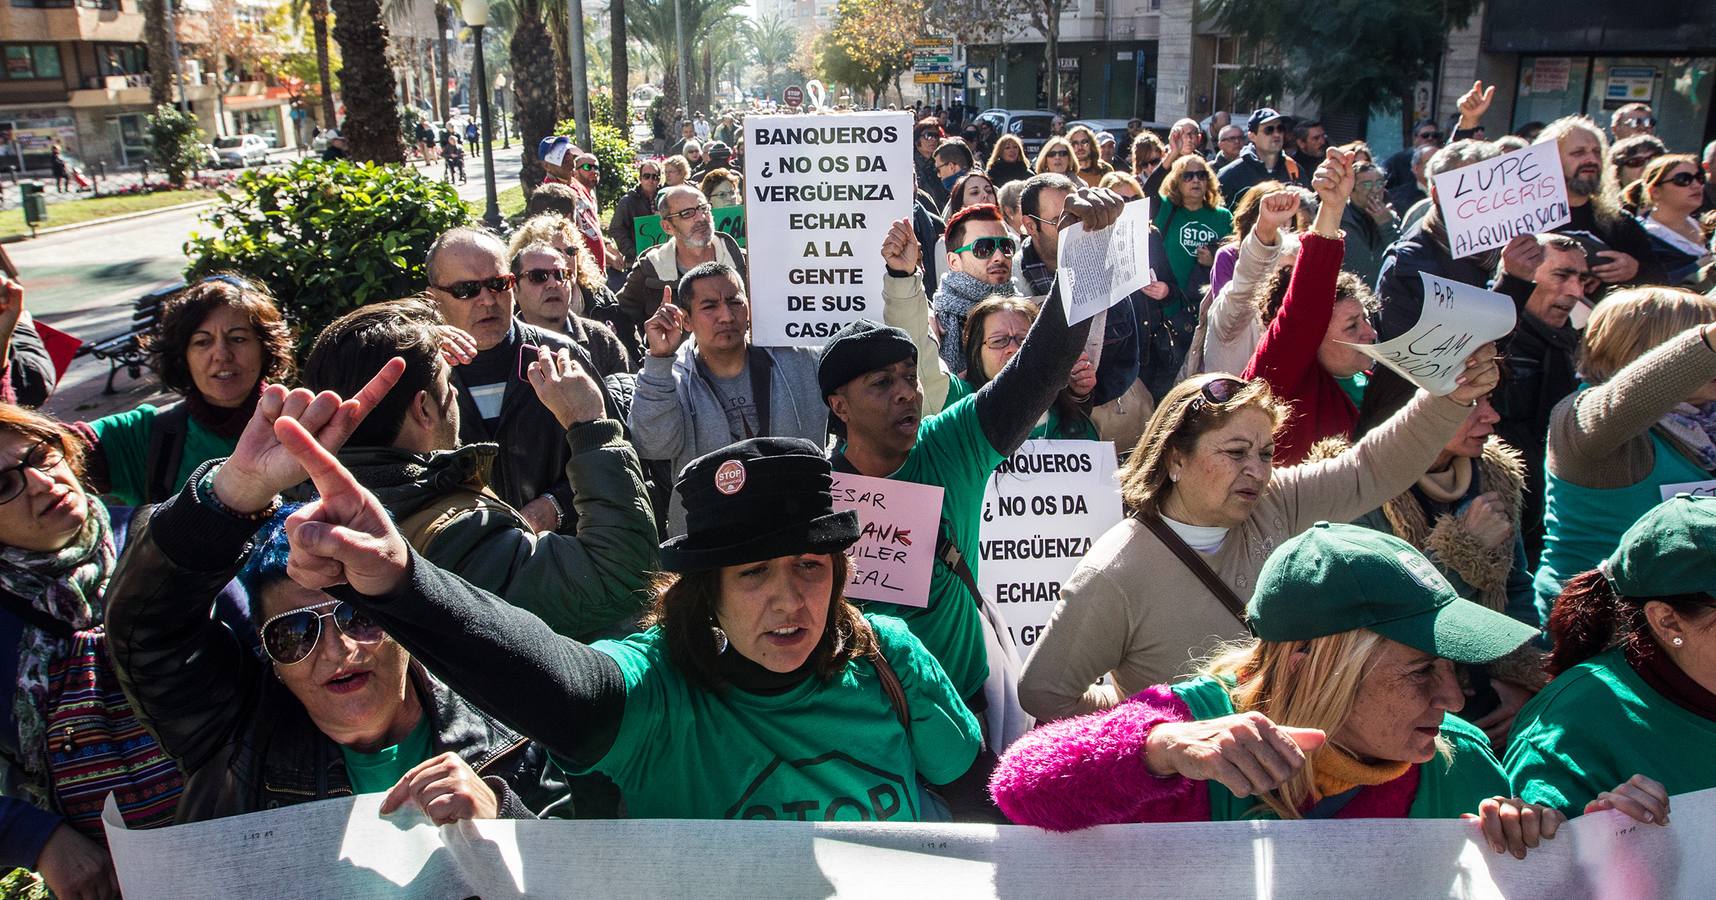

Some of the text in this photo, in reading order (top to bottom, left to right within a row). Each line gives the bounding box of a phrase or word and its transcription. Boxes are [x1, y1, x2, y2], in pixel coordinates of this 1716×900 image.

[755, 126, 898, 146] BANQUEROS
[761, 155, 887, 178] ¿ NO OS DA
[1454, 152, 1542, 198] LUPE
[754, 181, 895, 202] VERGÜENZA
[789, 212, 867, 230] ECHAR
[1183, 228, 1215, 242] STOP
[803, 240, 853, 257] A LA
[788, 268, 863, 285] GENTE
[787, 295, 866, 312] DE SUS
[785, 322, 852, 338] CASA
[718, 470, 741, 481] STOP
[831, 480, 886, 509] ÉSAR
[983, 494, 1088, 522] ¿ NO OS DA
[861, 521, 912, 547] ANK
[851, 570, 905, 591] IAL
[996, 581, 1062, 604] ECHAR
